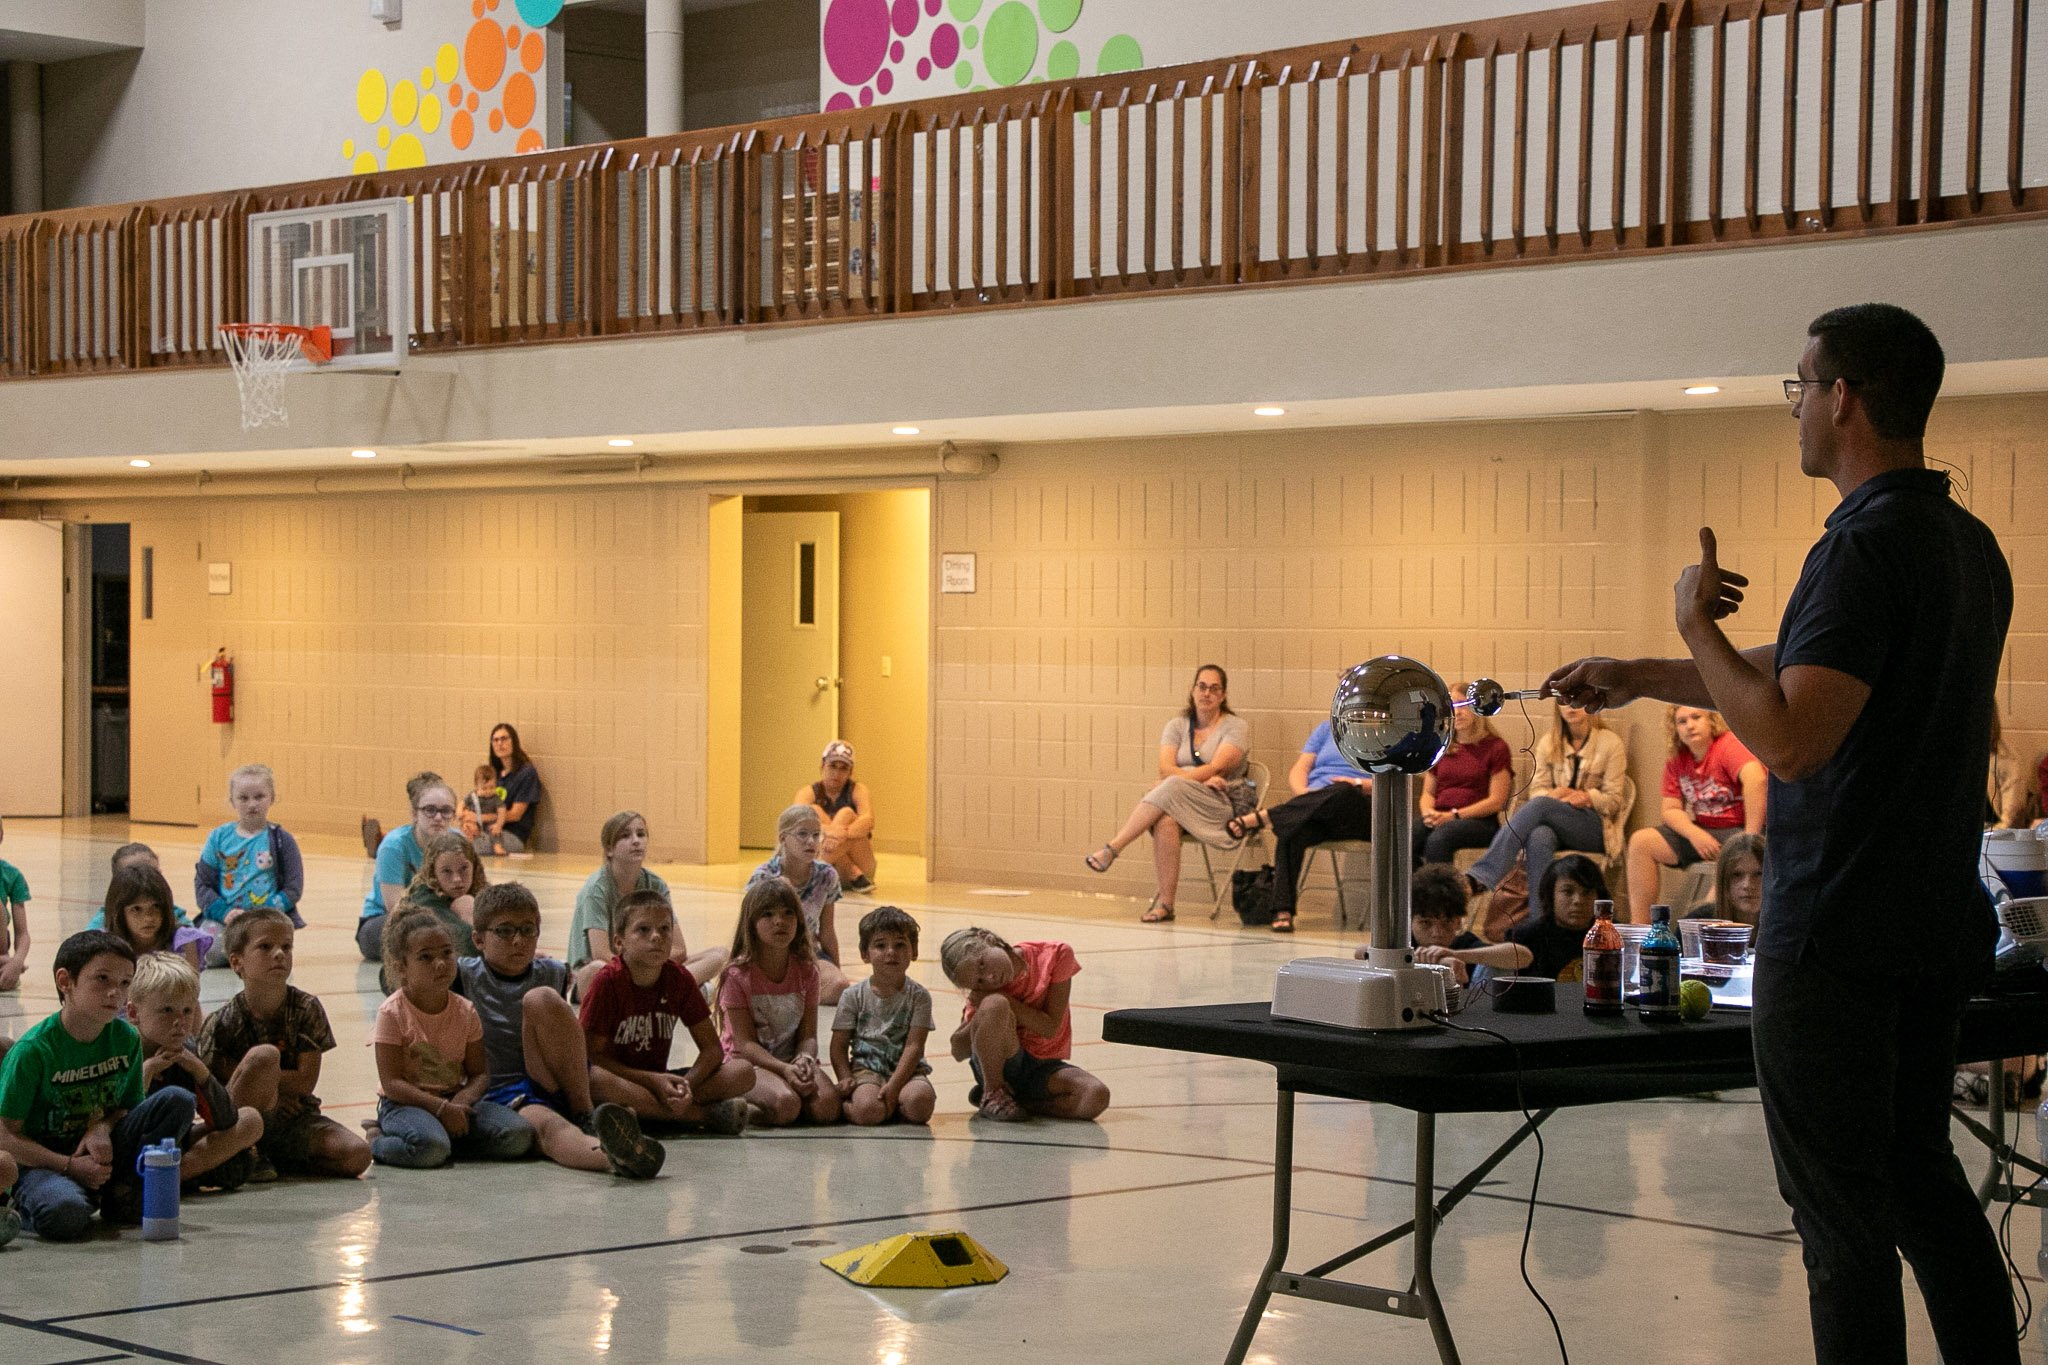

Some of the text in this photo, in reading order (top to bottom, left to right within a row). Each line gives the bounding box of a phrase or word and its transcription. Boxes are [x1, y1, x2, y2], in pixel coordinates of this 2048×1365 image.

[945, 560, 970, 573] Dining
[946, 576, 969, 586] Room
[51, 1055, 129, 1083] MINECRAFT
